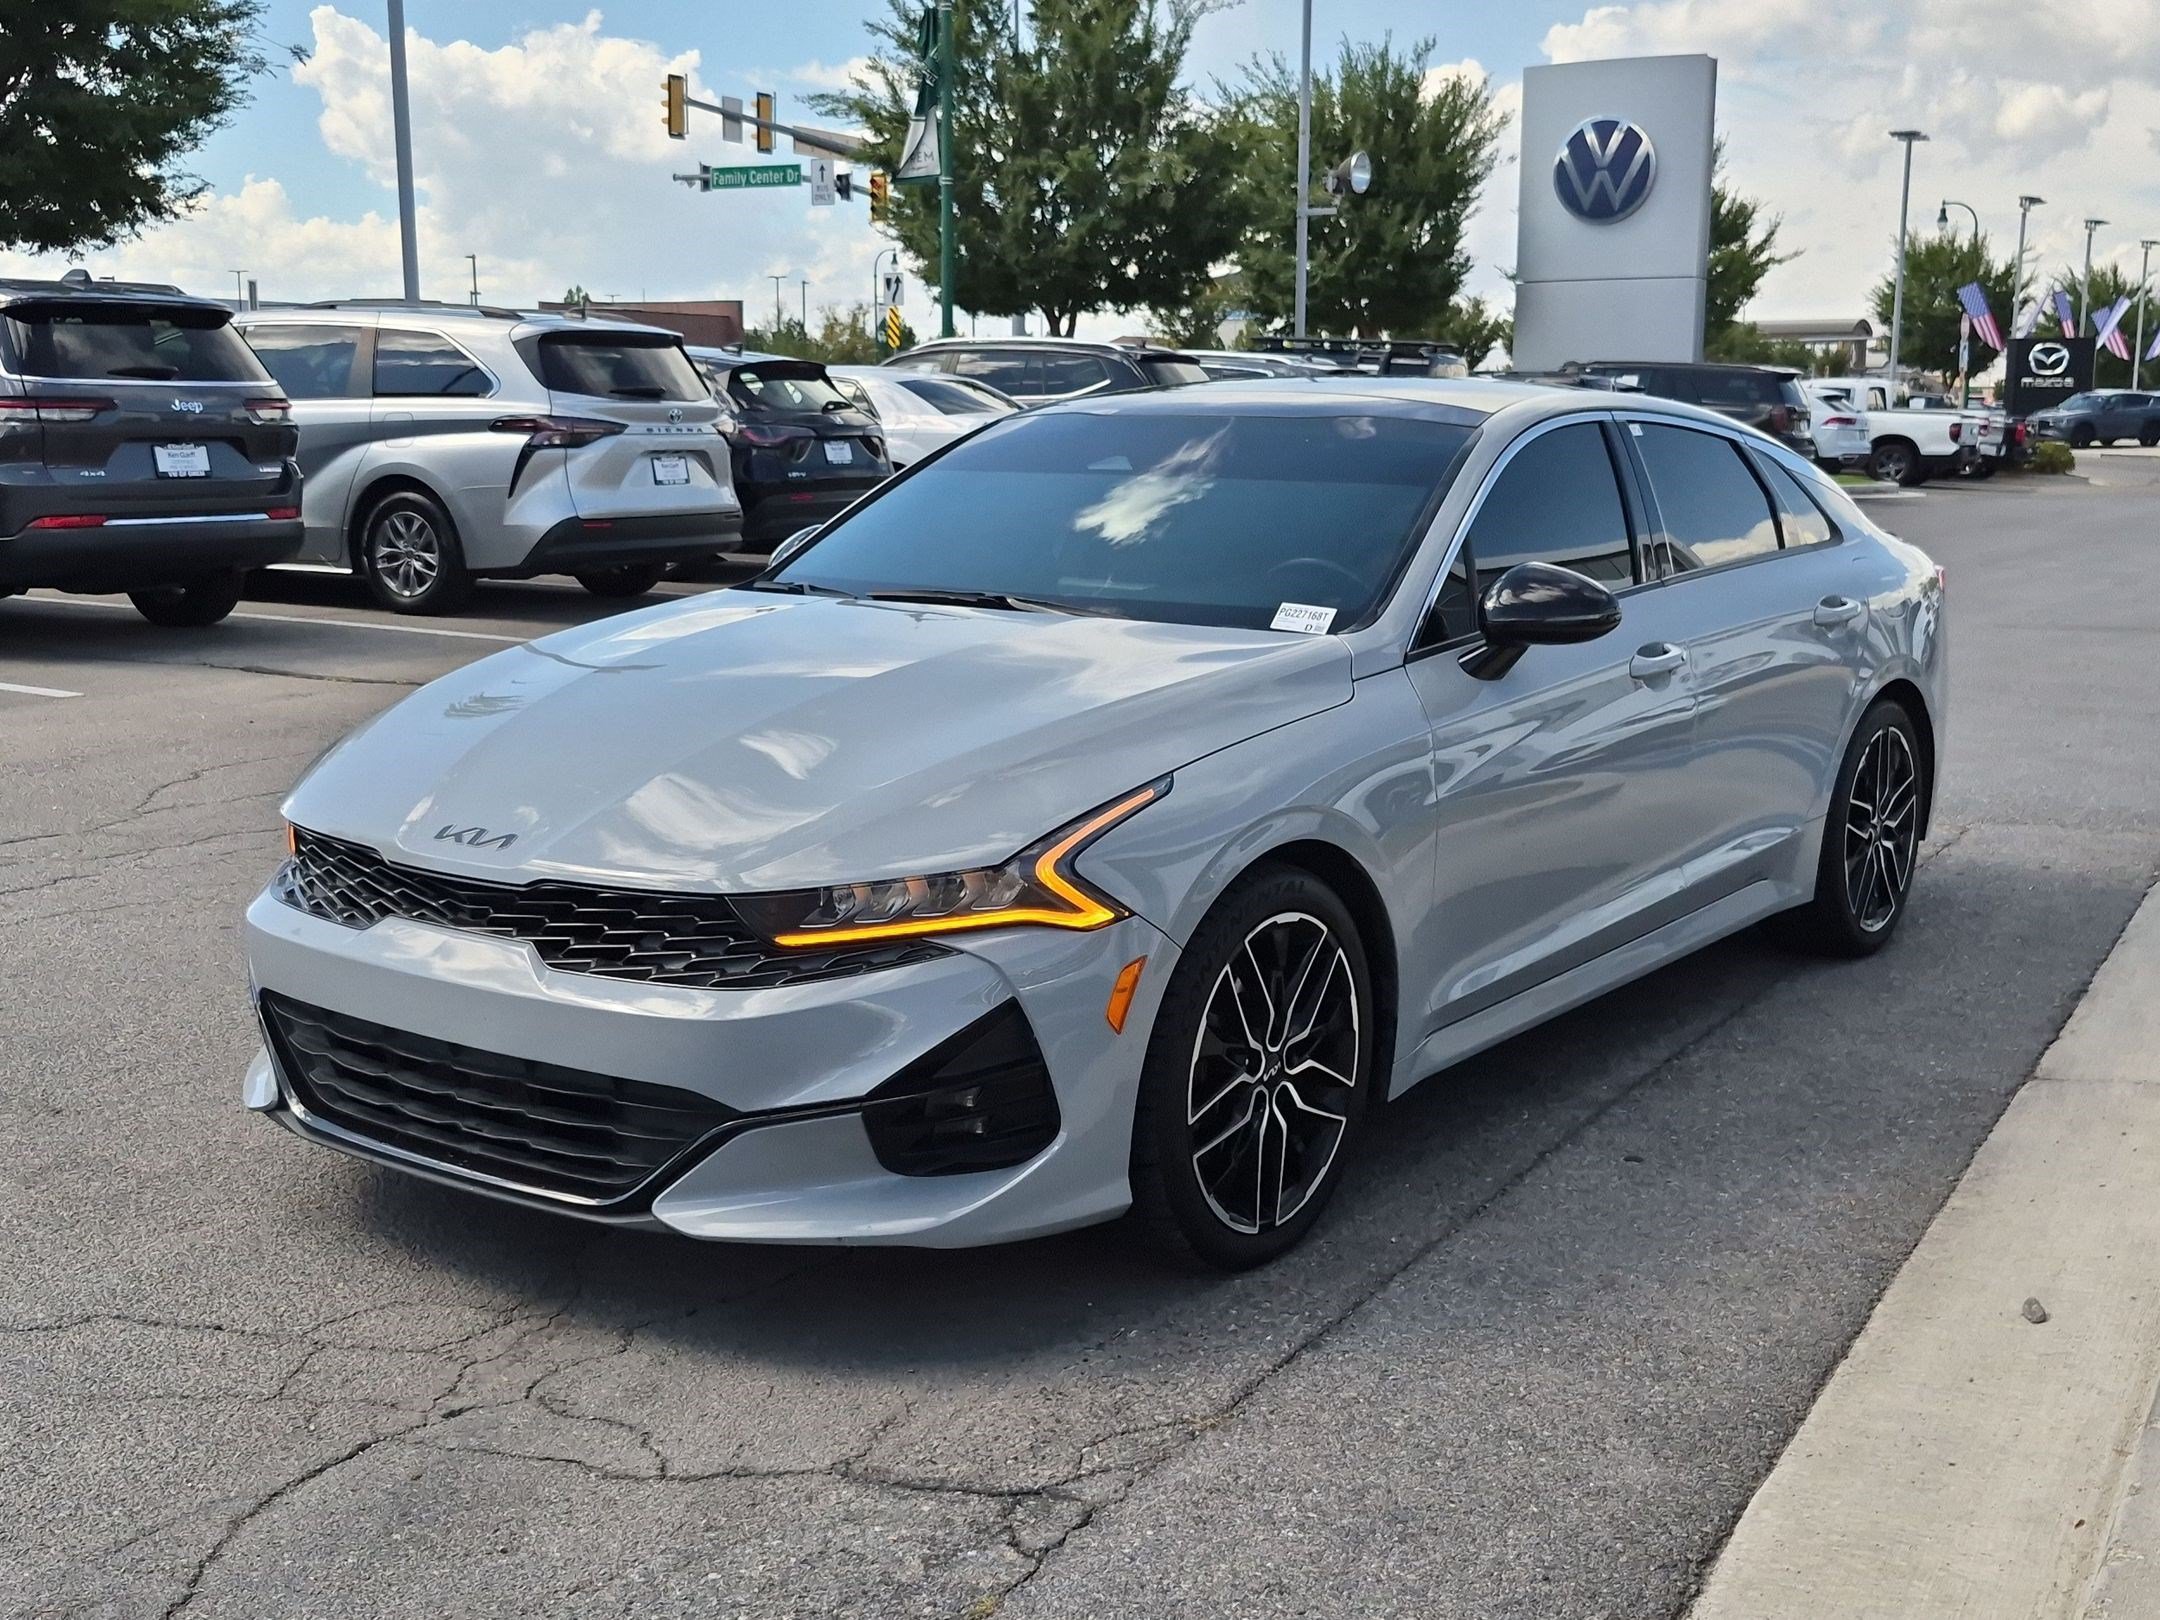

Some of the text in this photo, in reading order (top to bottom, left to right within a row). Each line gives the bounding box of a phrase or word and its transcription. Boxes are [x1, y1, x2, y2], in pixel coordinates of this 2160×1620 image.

[712, 169, 800, 188] Family Center Dr
[171, 398, 204, 414] Jeep
[1278, 607, 1329, 622] PG227168T
[433, 823, 519, 849] KIA
